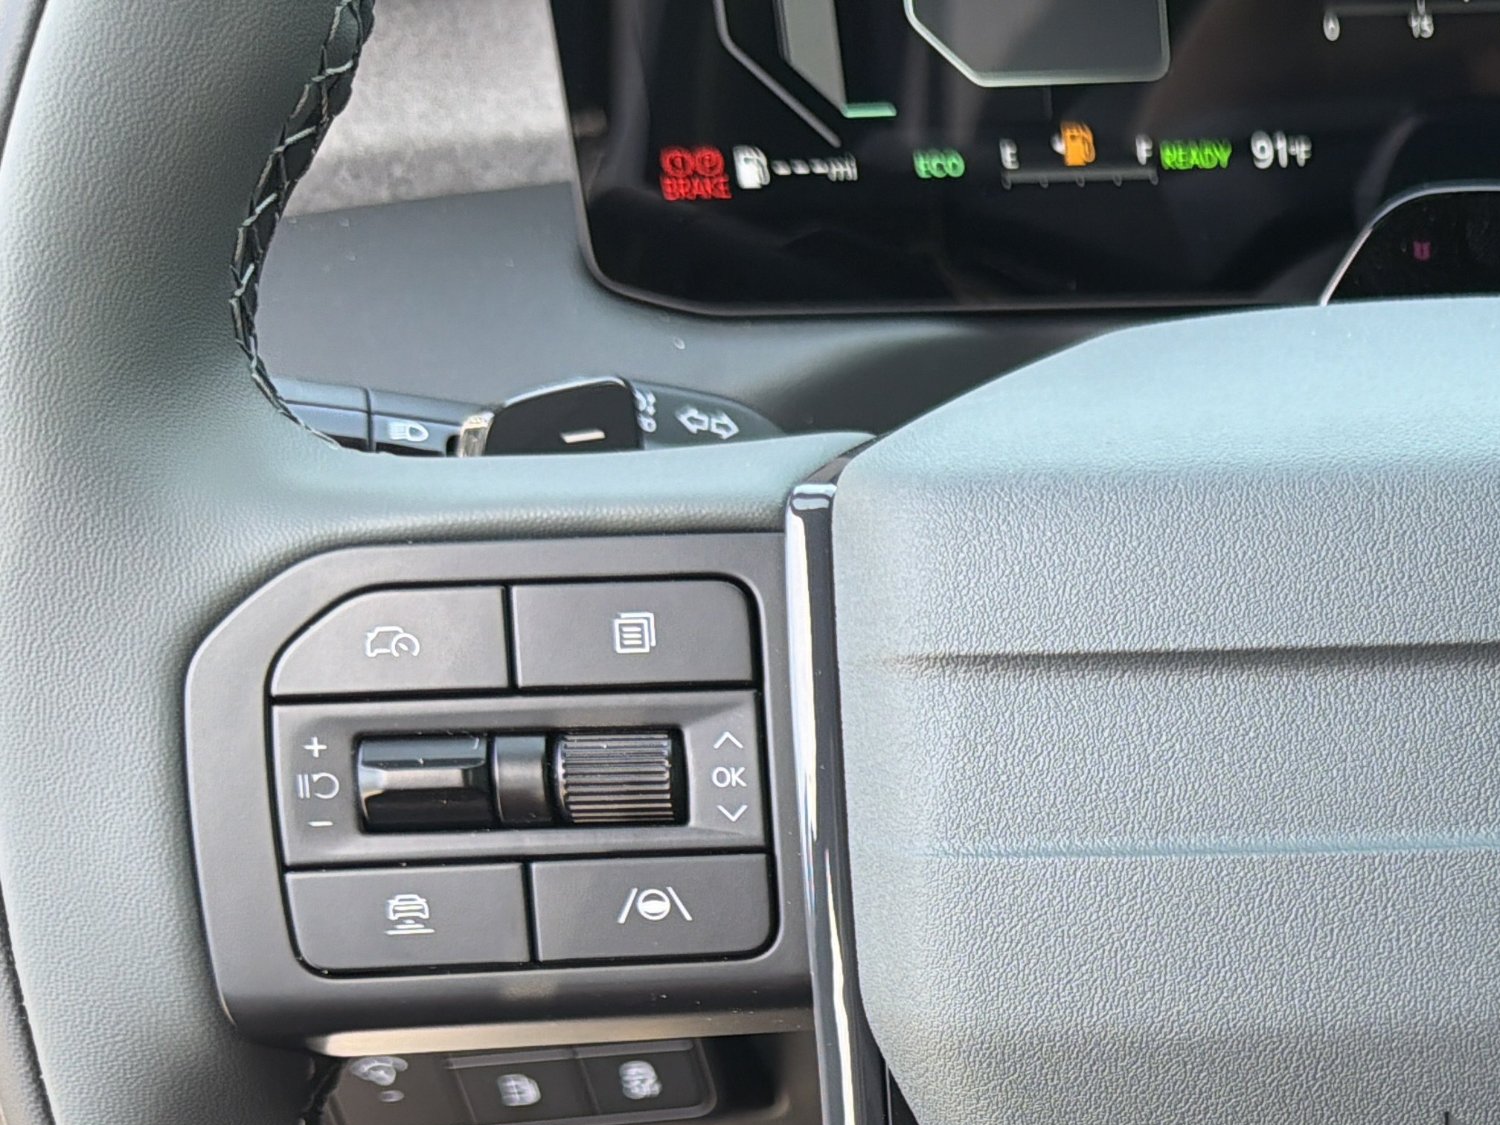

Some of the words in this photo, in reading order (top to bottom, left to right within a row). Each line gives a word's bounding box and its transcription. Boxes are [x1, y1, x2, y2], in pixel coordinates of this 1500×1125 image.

[912, 149, 965, 178] ECO
[1000, 137, 1020, 170] E
[1135, 133, 1154, 166] F
[1159, 136, 1233, 171] READY
[660, 172, 732, 201] BRAKE
[711, 766, 748, 789] OK
